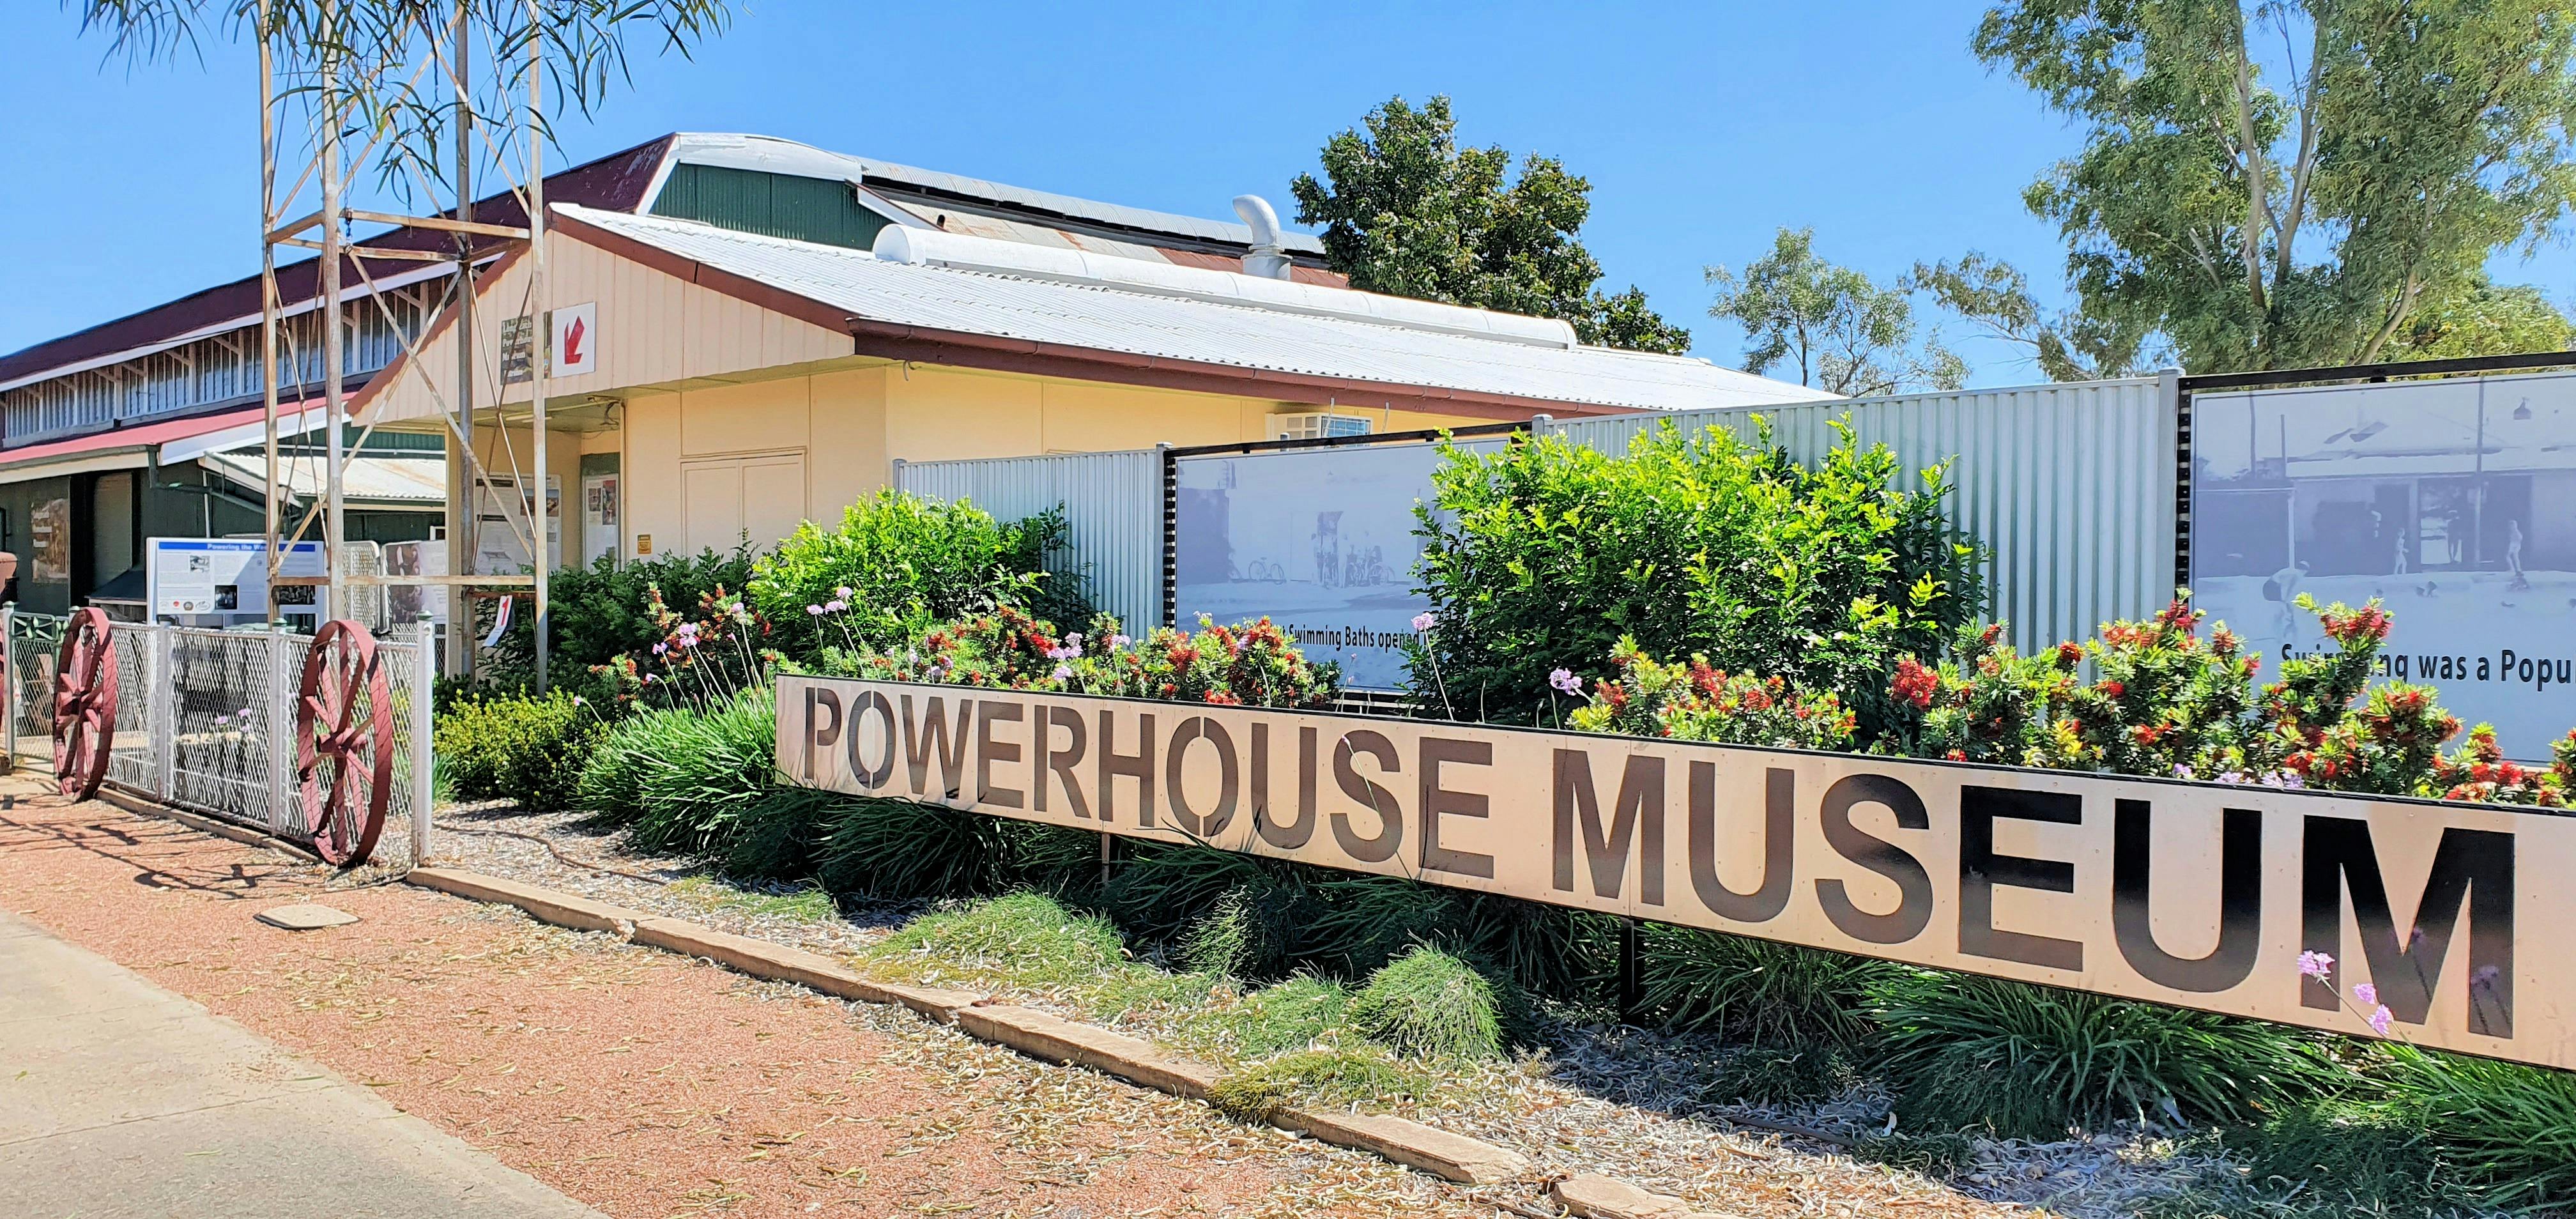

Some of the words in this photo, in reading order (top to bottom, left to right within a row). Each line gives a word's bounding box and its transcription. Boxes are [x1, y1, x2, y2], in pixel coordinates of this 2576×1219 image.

[1289, 624, 1341, 651] Swimming
[1345, 625, 1374, 647] Baths
[1378, 628, 1420, 653] opened
[2418, 654, 2467, 680] was
[2476, 656, 2490, 681] a
[2501, 648, 2576, 692] Popu
[804, 687, 1494, 880] POWERHOUSE
[1552, 748, 2515, 1039] MUSEUM
